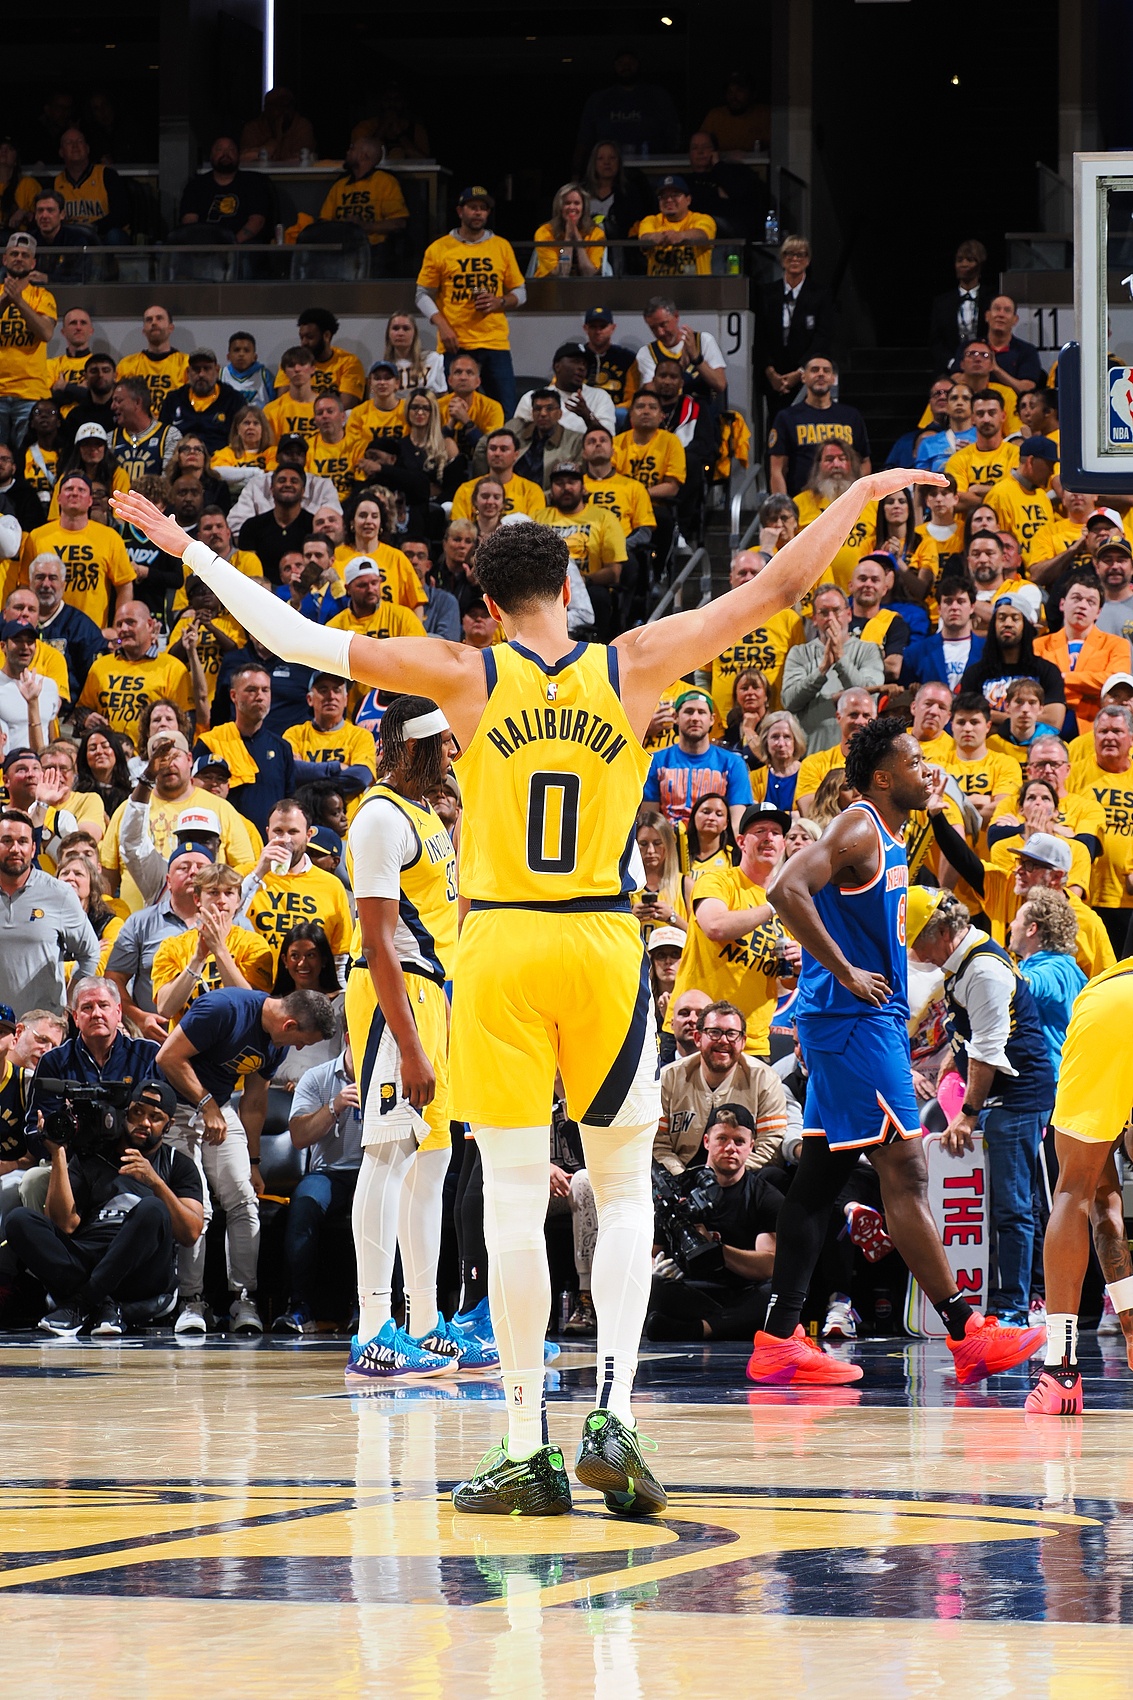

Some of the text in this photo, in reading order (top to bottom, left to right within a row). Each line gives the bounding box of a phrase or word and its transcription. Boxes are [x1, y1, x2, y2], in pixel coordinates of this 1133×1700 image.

[342, 191, 371, 205] YES
[64, 200, 104, 217] DIANA
[457, 258, 493, 272] YES
[727, 312, 741, 354] 9
[1034, 308, 1061, 351] 11
[311, 370, 332, 384] ES
[286, 416, 319, 431] YES
[369, 425, 404, 440] YES
[796, 423, 853, 446] PACERS
[1113, 427, 1129, 440] NBA
[32, 462, 57, 476] YE
[314, 457, 348, 473] YES
[1022, 504, 1048, 521] YE
[53, 545, 94, 561] YES
[127, 547, 159, 565] NDY
[65, 562, 100, 579] ERS
[64, 577, 99, 592] TION
[742, 628, 768, 644] ES
[108, 674, 145, 691] YES
[486, 708, 628, 766] HALIBURTON
[306, 748, 345, 763] YES
[1092, 787, 1133, 808] YES
[526, 770, 581, 874] 0
[267, 891, 317, 914] YES
[761, 916, 785, 938] ES
[671, 1110, 695, 1134] EW
[943, 1168, 985, 1246] THE
